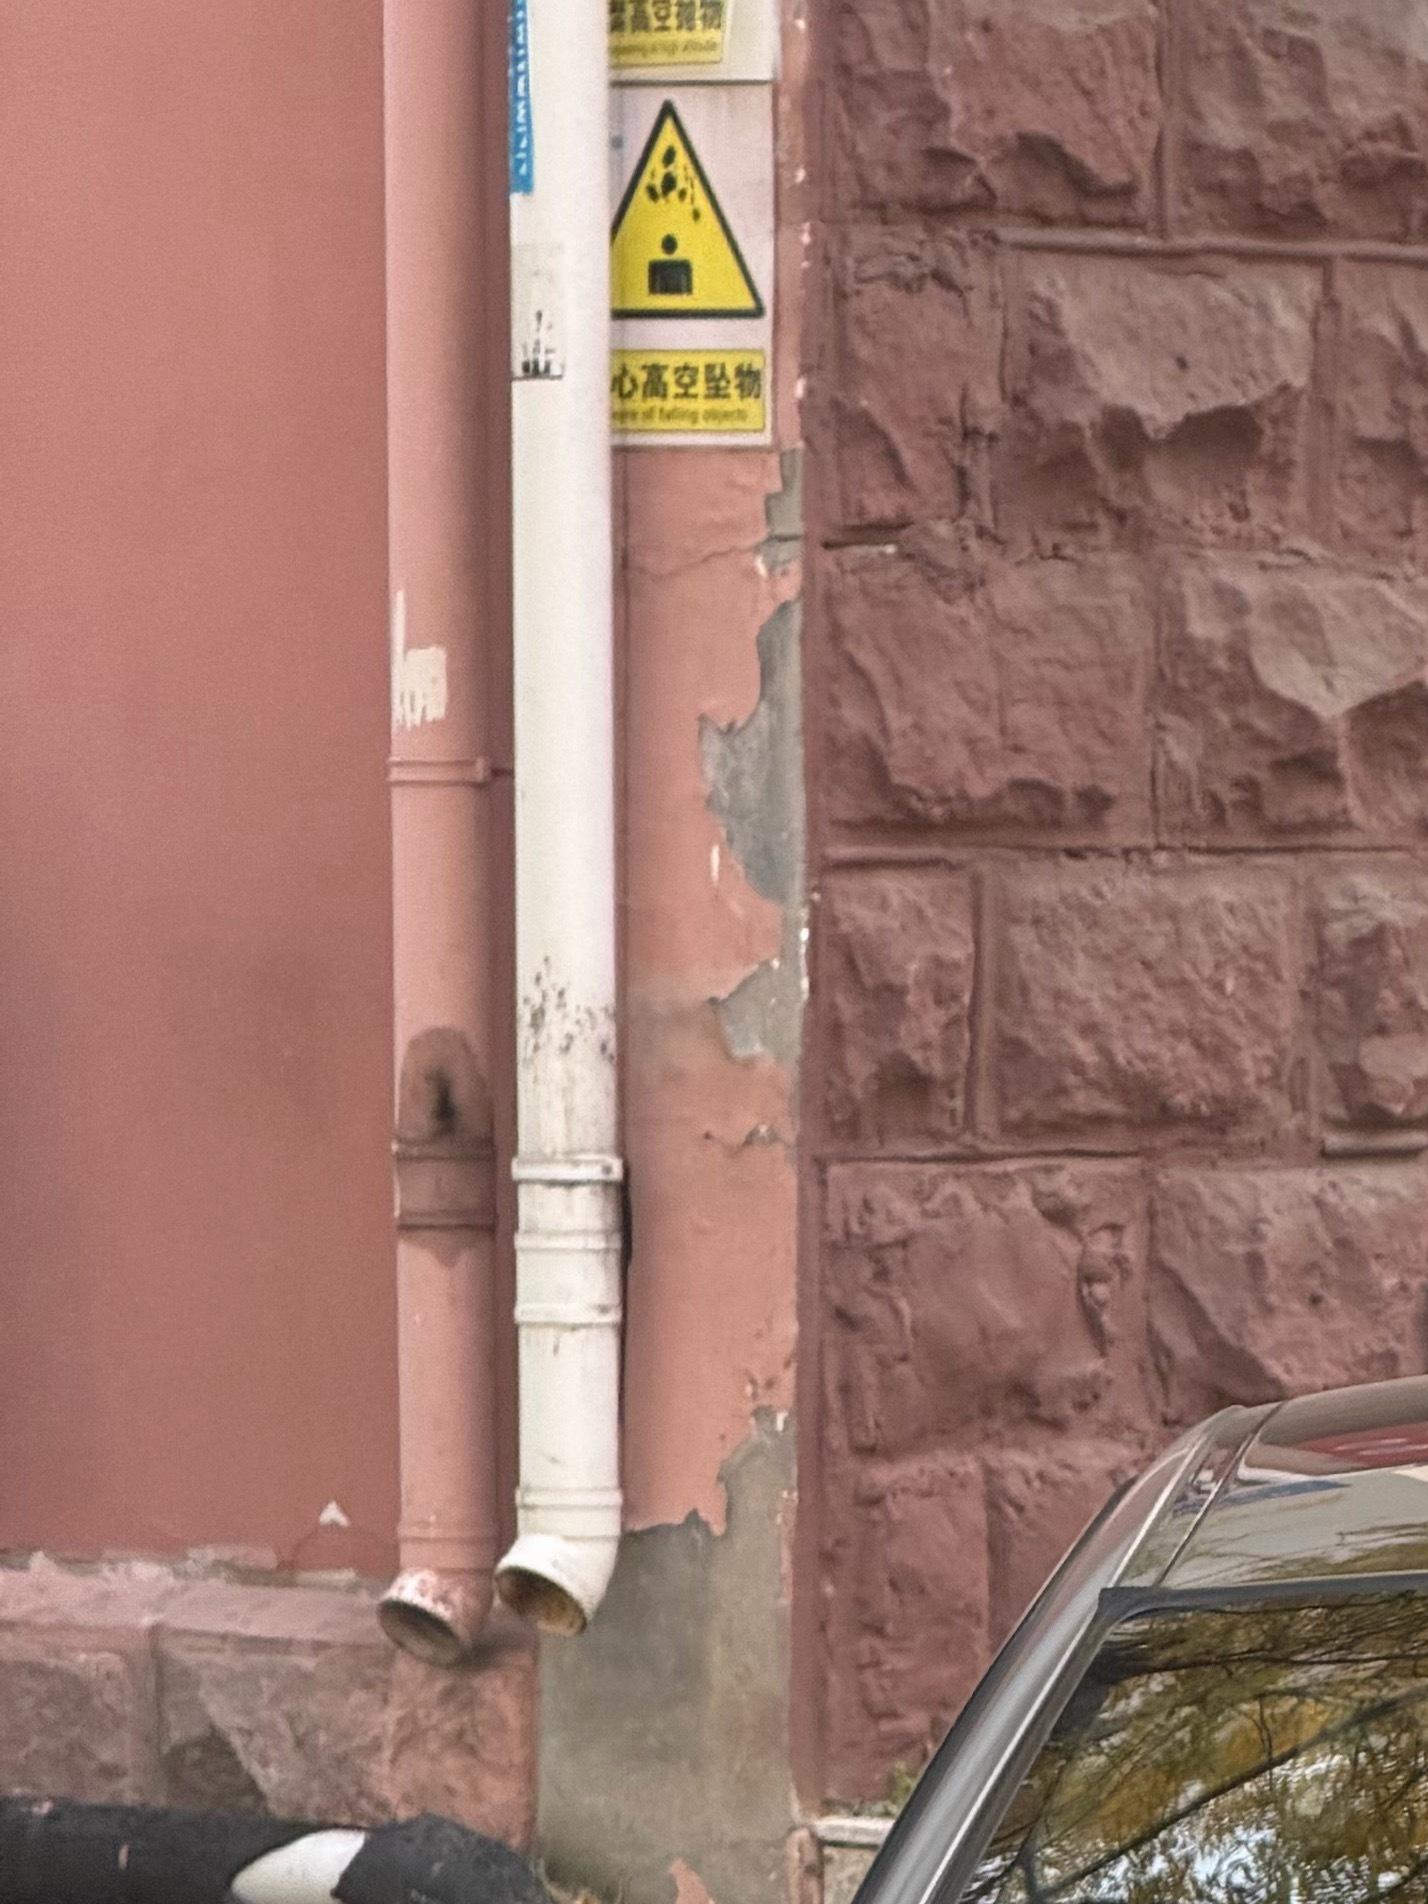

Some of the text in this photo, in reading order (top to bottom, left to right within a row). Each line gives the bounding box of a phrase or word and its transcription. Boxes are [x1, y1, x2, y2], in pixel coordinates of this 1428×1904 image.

[611, 362, 762, 400] 心高空坠物
